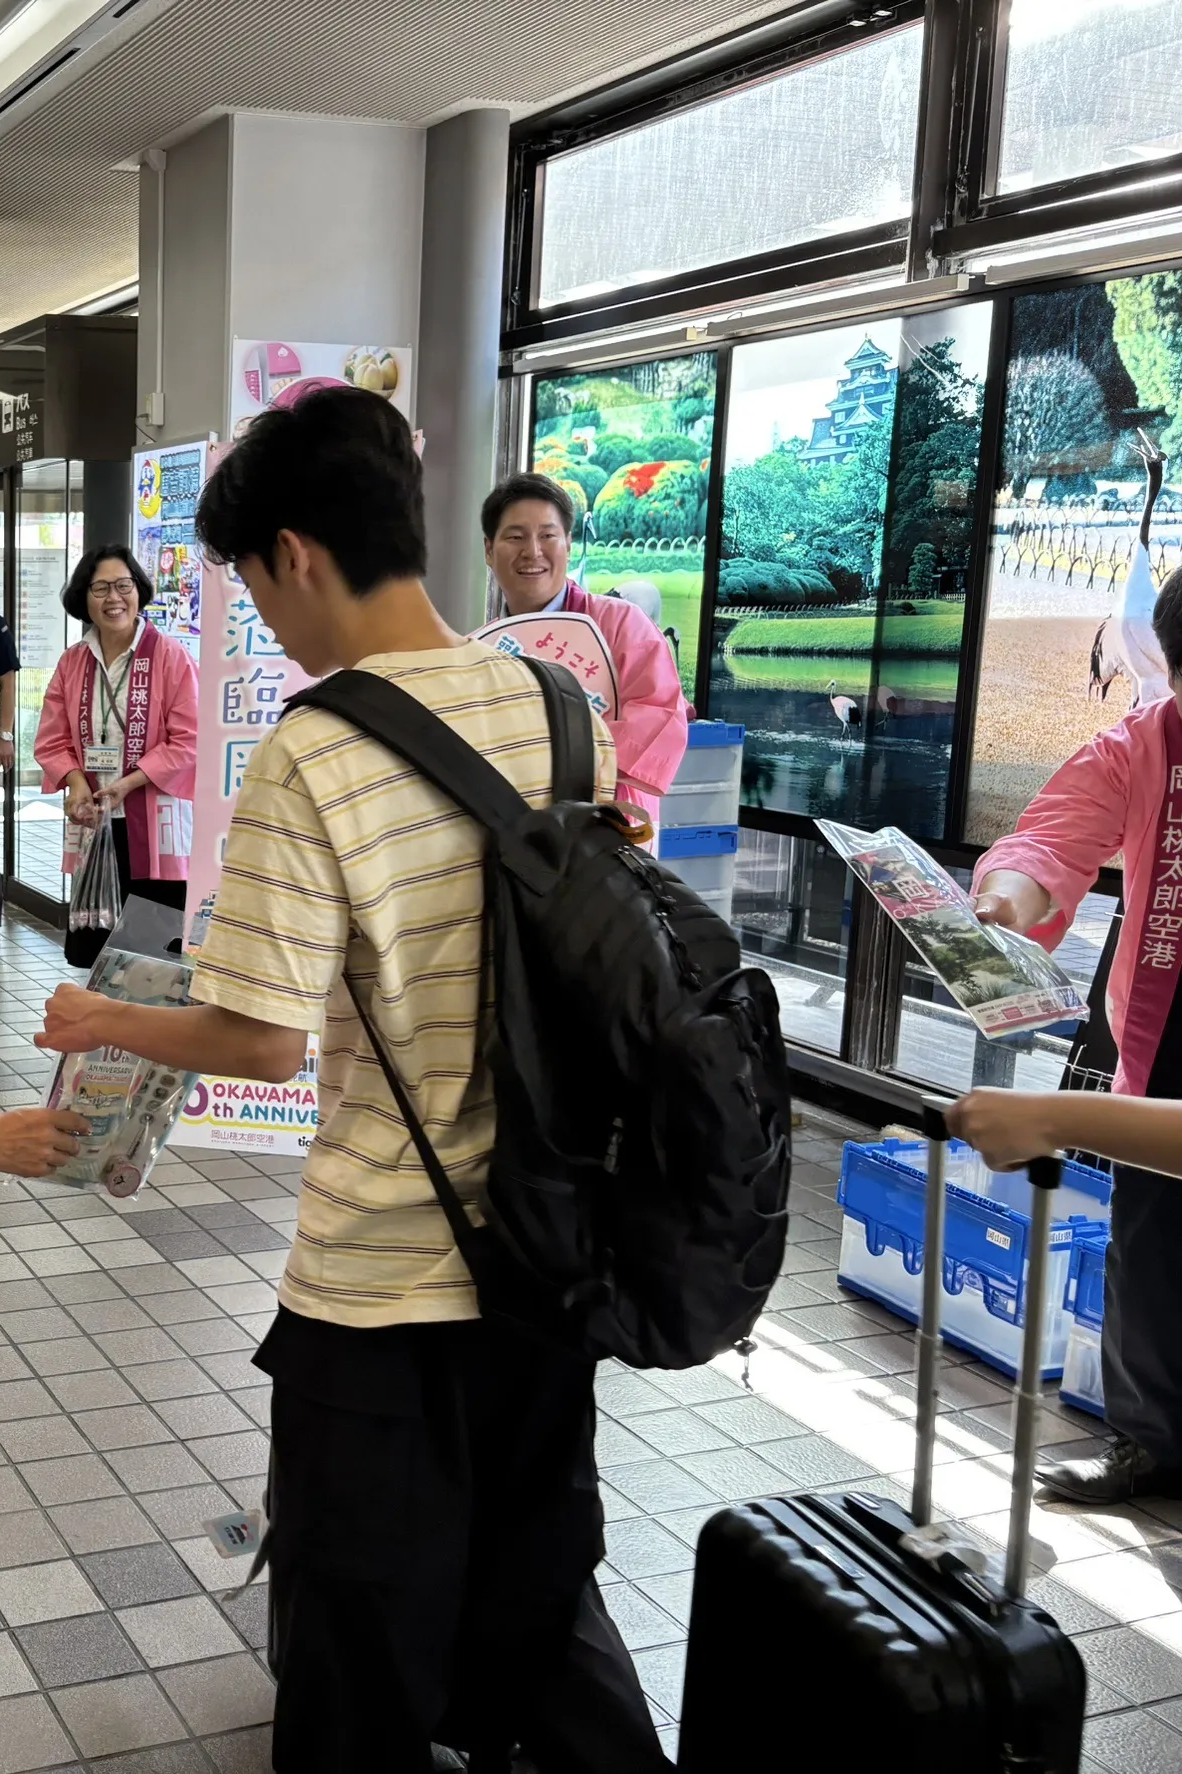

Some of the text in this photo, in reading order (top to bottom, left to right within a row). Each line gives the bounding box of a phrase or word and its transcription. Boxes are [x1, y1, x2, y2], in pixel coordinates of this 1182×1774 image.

[16, 416, 26, 430] Bus
[535, 631, 600, 678] ようこそ
[212, 1082, 317, 1106] OKAYAMA
[210, 1129, 275, 1145] 岡山桃太郎空港
